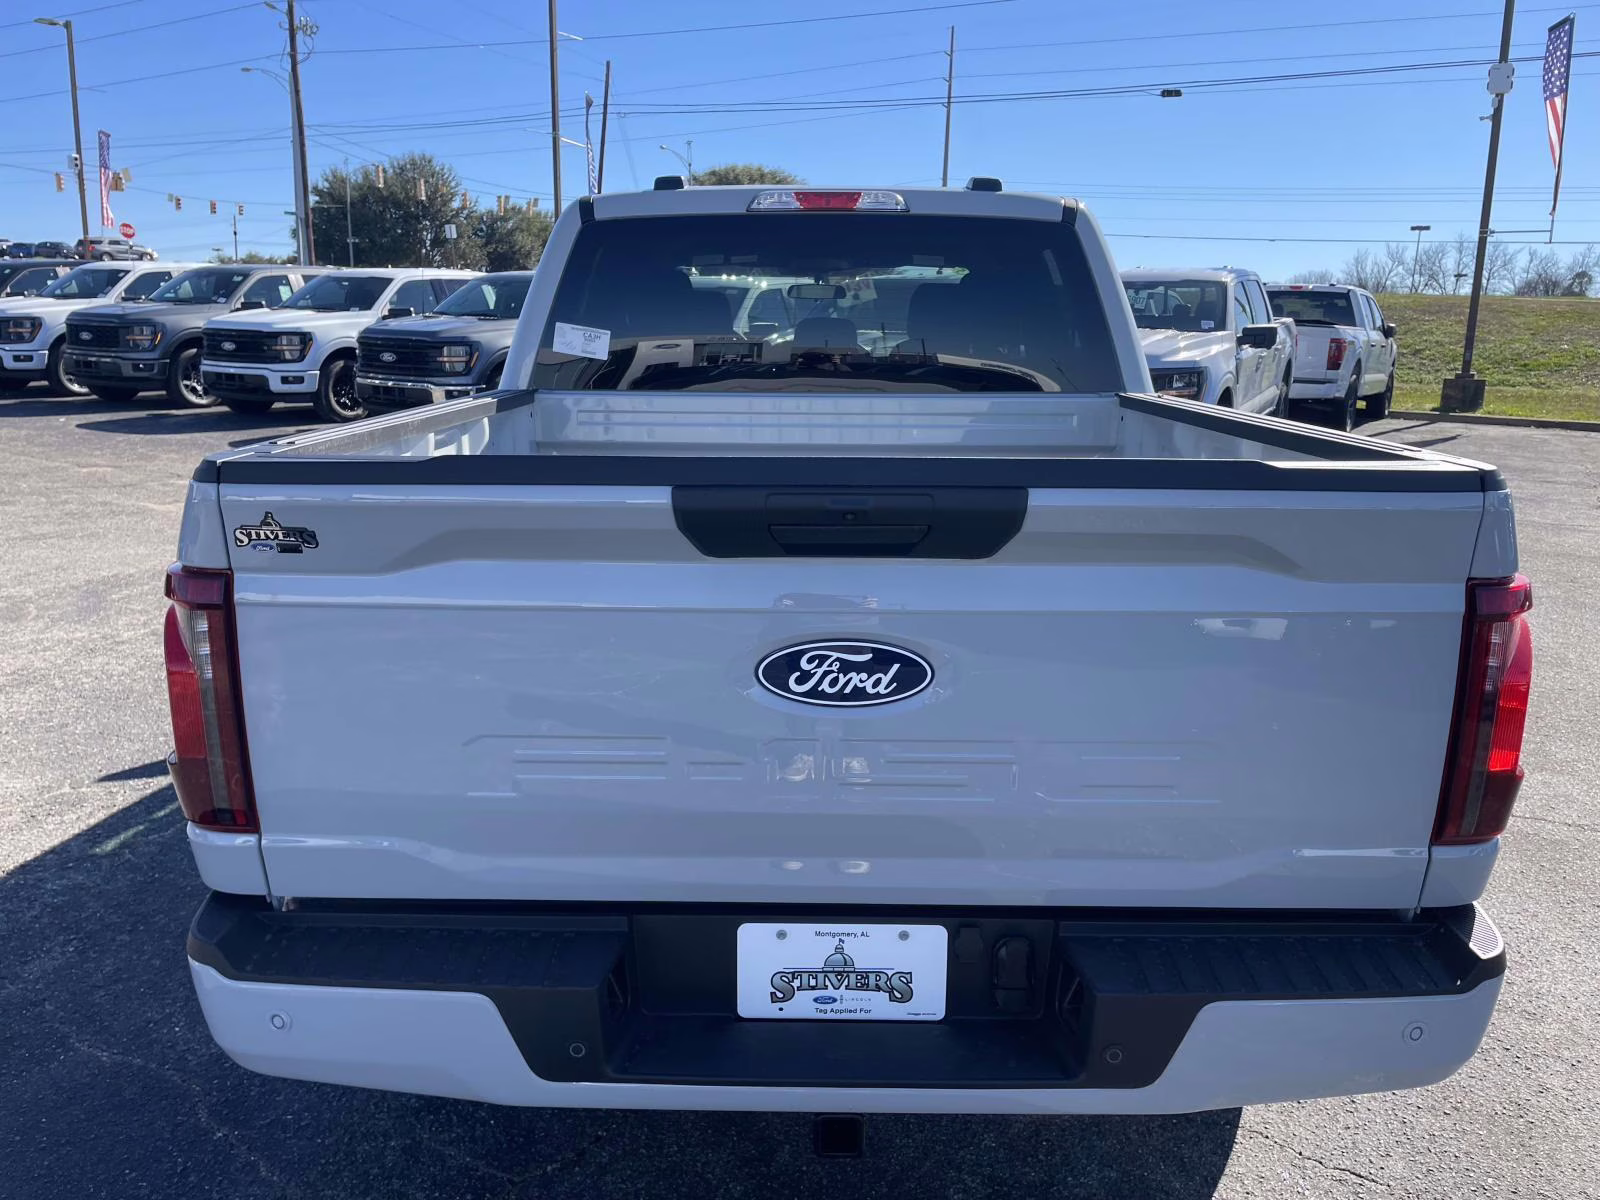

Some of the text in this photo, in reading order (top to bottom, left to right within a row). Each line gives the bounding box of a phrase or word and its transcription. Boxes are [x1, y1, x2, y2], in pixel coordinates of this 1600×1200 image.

[234, 529, 319, 548] STIVERS
[788, 650, 901, 695] Ford
[814, 931, 858, 939] Montgomery,
[770, 971, 914, 1003] STIVERS
[815, 1007, 828, 1015] Tag
[830, 1007, 858, 1015] Applied
